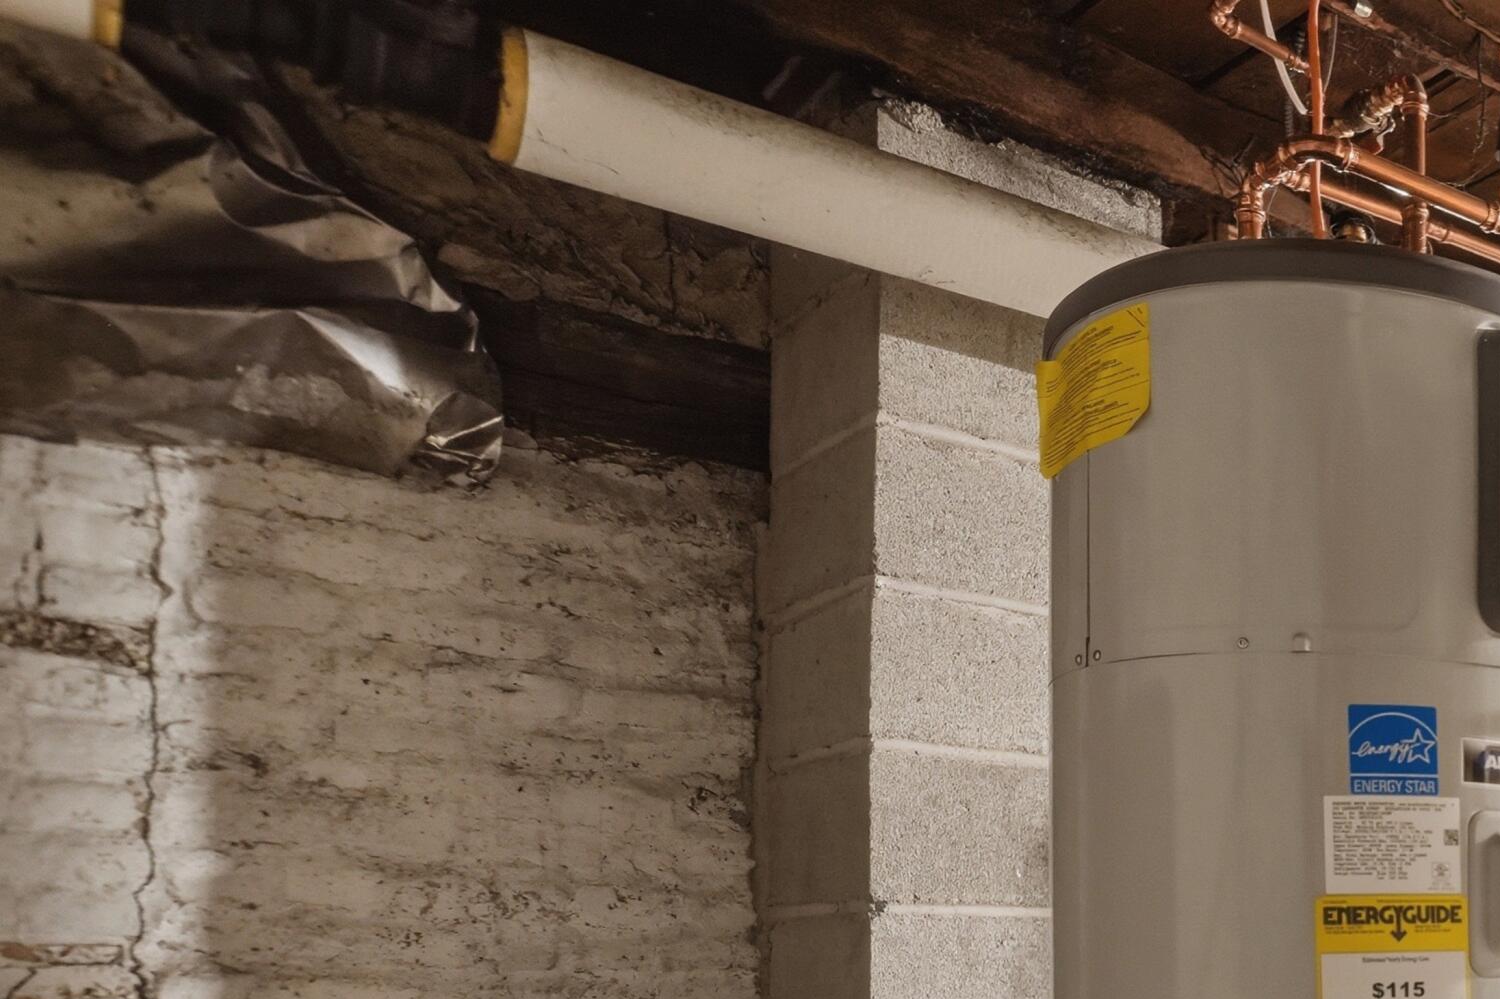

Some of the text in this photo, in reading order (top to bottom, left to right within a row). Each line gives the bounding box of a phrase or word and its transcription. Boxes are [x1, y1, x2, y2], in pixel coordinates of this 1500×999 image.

[1354, 780, 1436, 793] ENERGY STAR
[1372, 981, 1425, 999] $115
